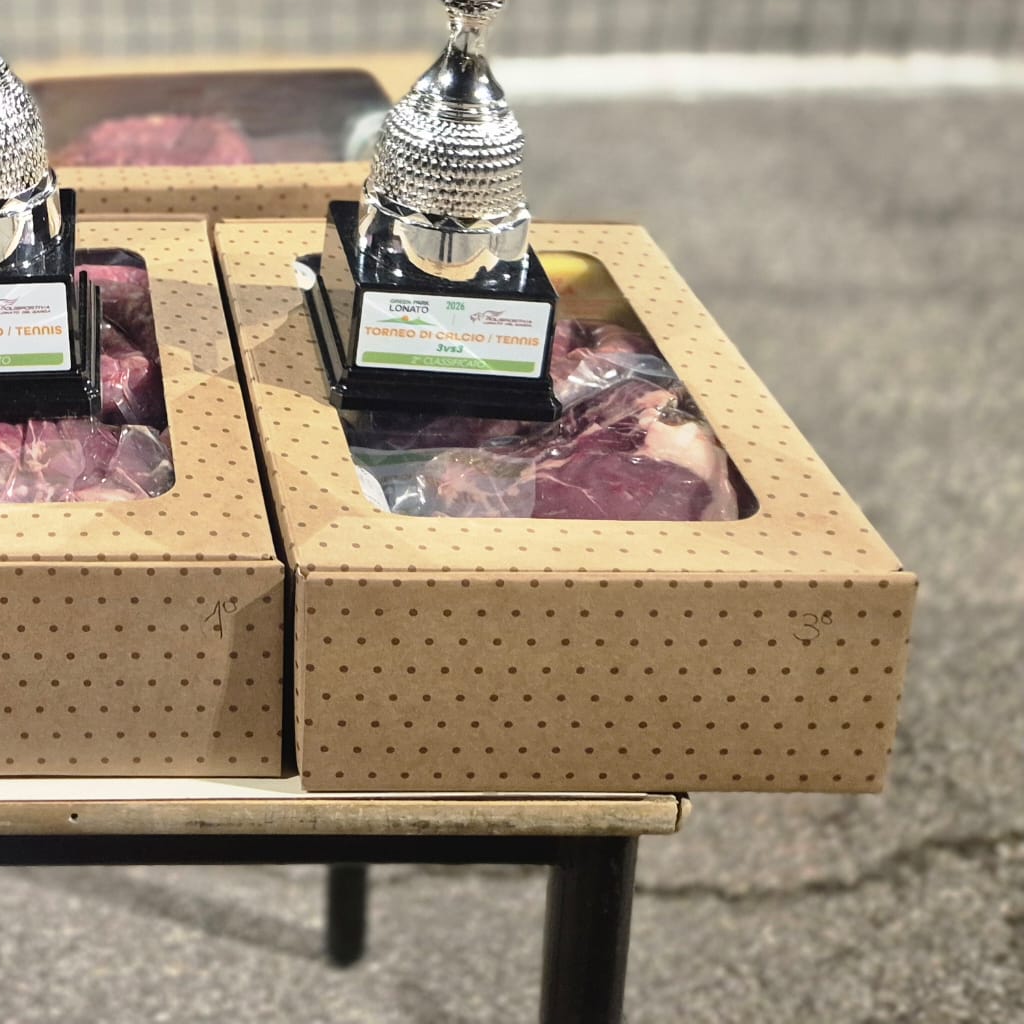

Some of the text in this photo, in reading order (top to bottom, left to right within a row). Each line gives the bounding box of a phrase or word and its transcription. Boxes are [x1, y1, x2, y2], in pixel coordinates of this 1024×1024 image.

[389, 304, 430, 314] LONATO
[446, 300, 465, 311] 2026
[15, 325, 63, 336] TENNIS
[364, 326, 416, 339] TORNEO
[419, 330, 432, 339] DI
[435, 331, 485, 343] CALCIO
[495, 334, 540, 347] TENNIS
[436, 343, 464, 354] 3vs3
[423, 357, 487, 368] CLASSIFICATO
